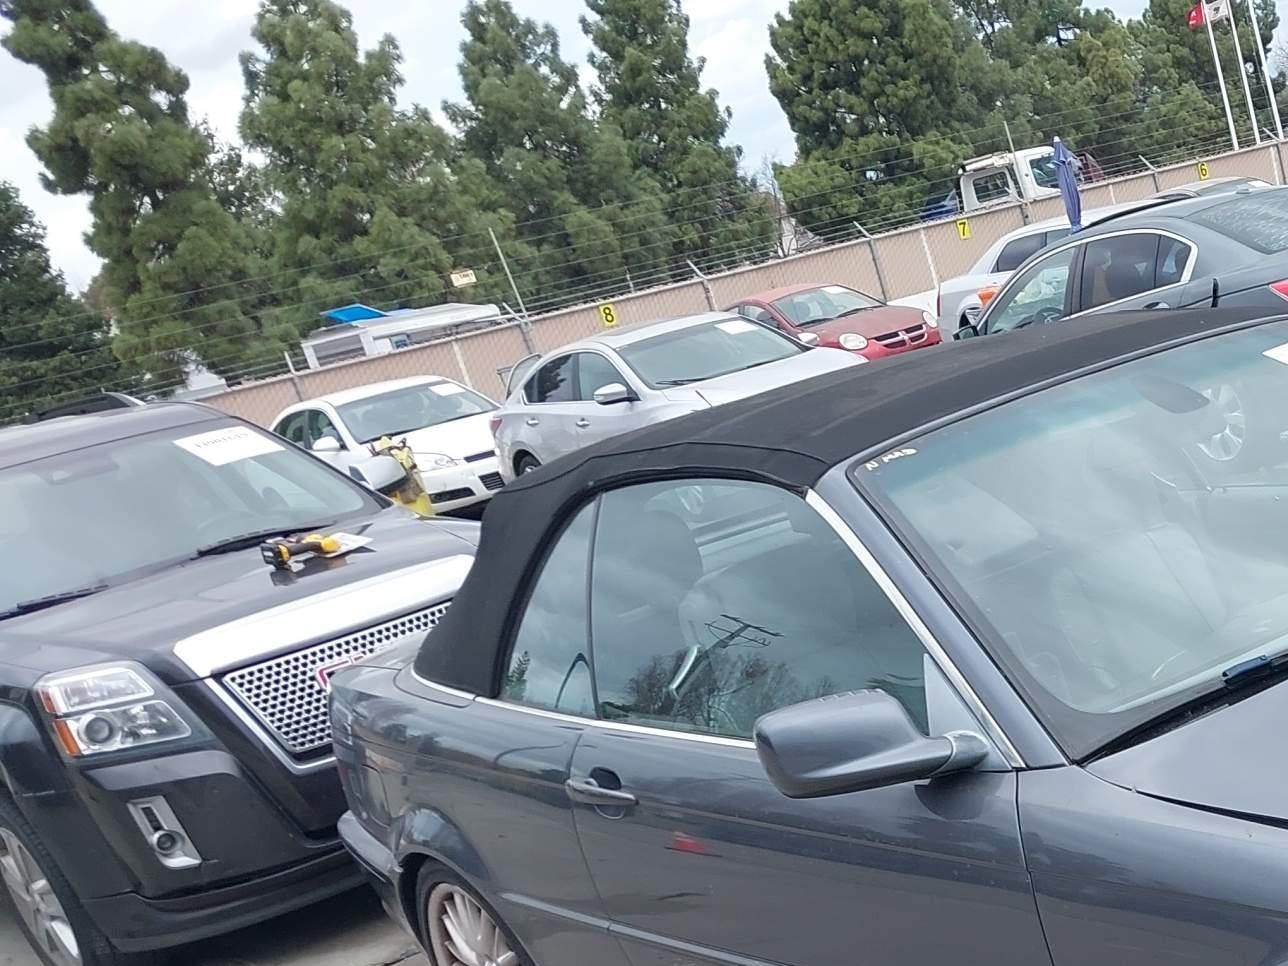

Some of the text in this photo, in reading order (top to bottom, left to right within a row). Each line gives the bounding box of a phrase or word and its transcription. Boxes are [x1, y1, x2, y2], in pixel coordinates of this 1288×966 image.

[1200, 163, 1207, 177] 6
[958, 221, 966, 237] 7
[603, 307, 614, 323] 8
